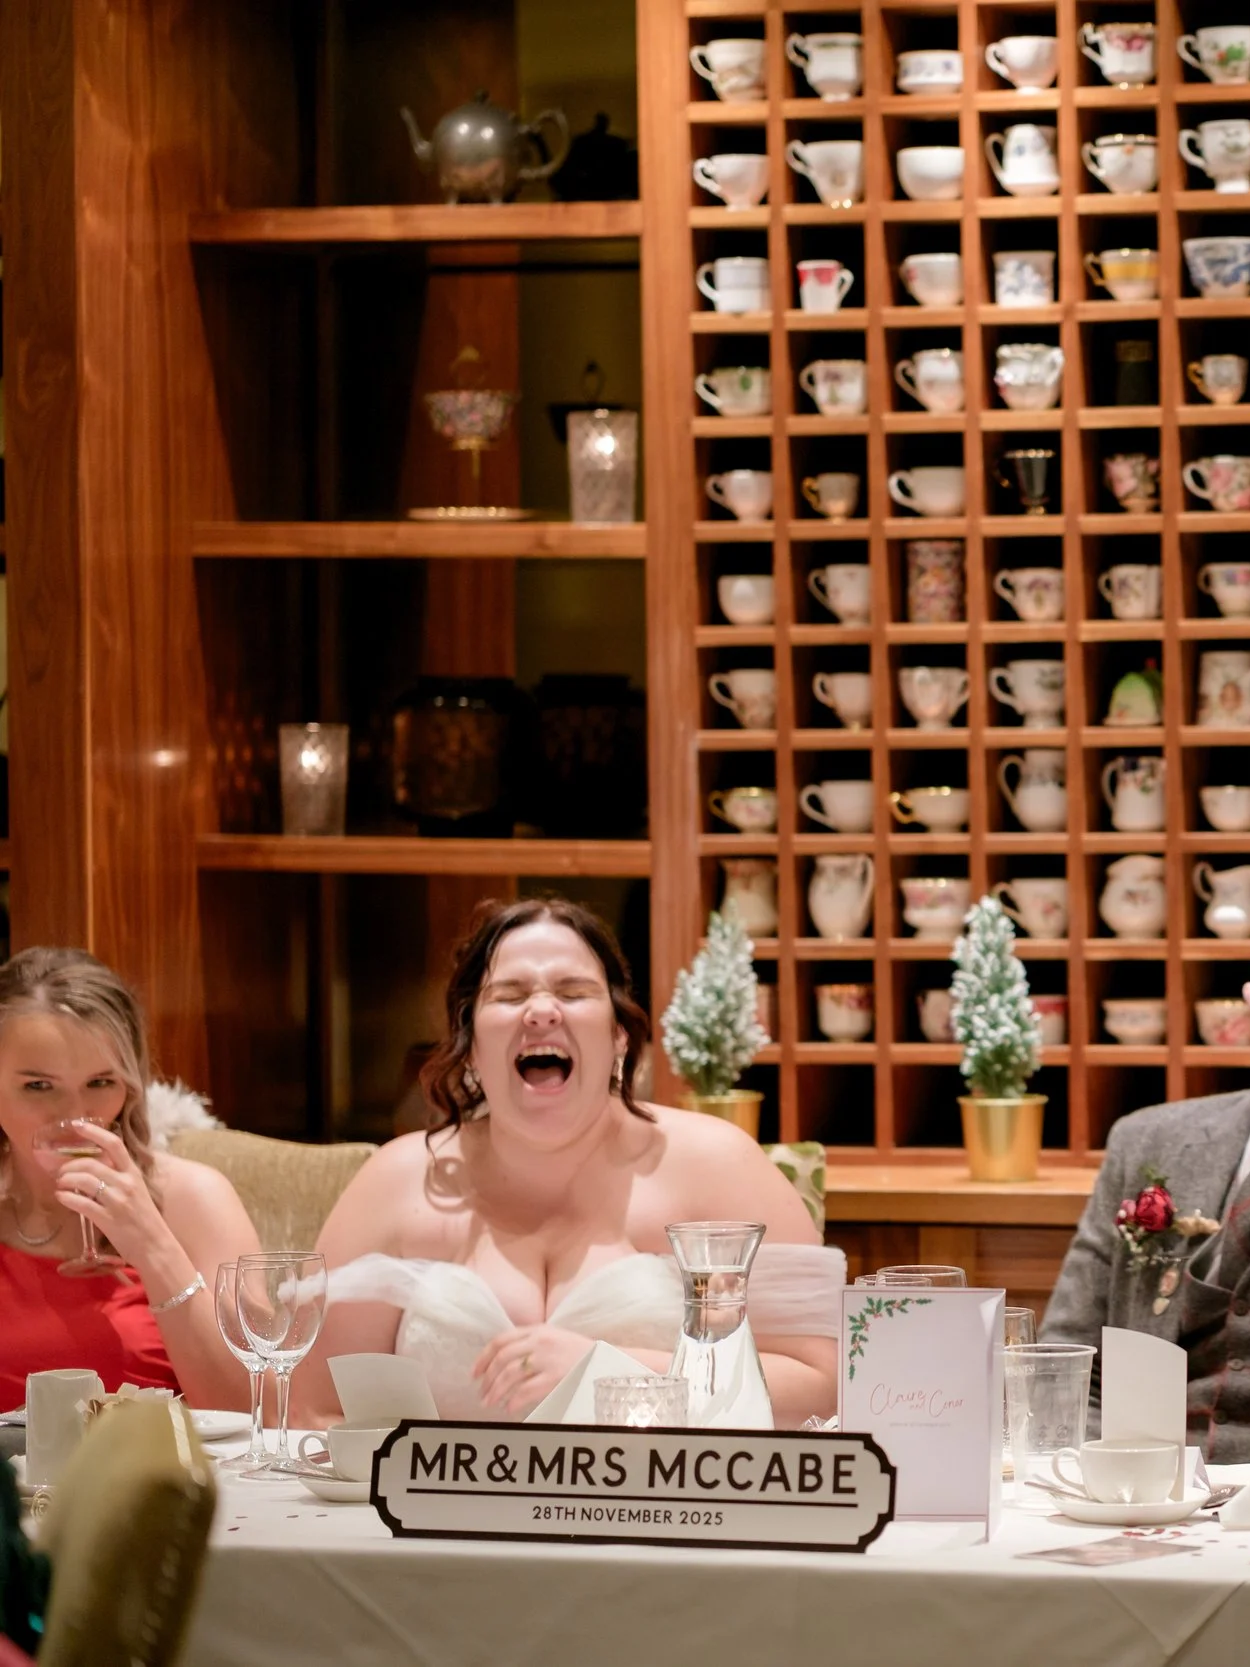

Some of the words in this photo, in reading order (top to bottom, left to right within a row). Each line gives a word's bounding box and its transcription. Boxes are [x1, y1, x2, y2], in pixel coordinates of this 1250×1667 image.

[869, 1382, 927, 1416] Claire
[647, 1448, 857, 1495] MCCABE
[532, 1505, 576, 1521] 28TH
[580, 1507, 673, 1524] NOVEMBER
[679, 1510, 723, 1526] 2025
